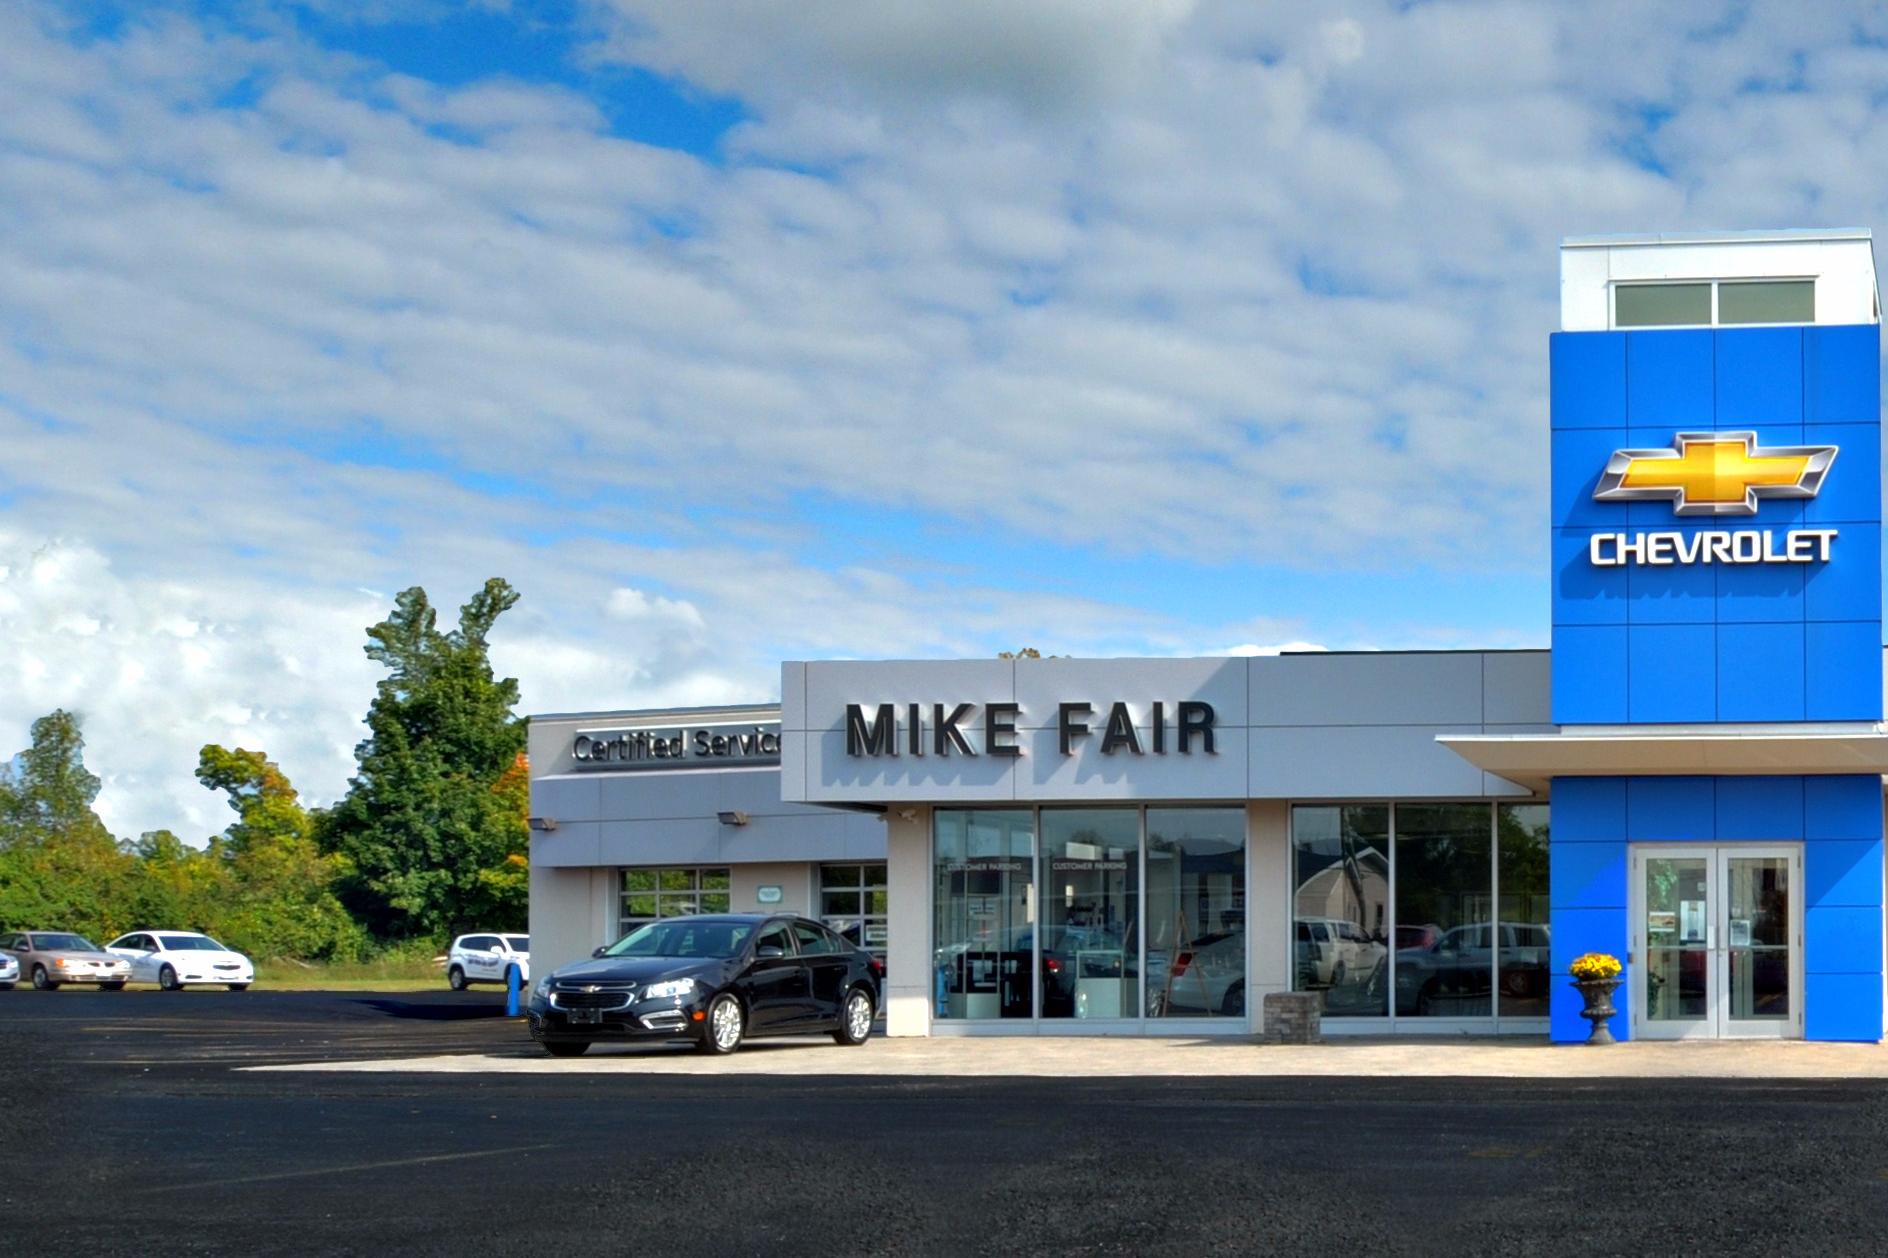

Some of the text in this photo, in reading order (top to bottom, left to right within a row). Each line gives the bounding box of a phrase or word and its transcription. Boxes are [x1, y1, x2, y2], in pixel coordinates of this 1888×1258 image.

[1590, 529, 1839, 566] CHEVROLET
[573, 730, 688, 762] Certified
[845, 700, 1218, 758] MIKE FAIR
[1052, 862, 1093, 870] CUSTOMER
